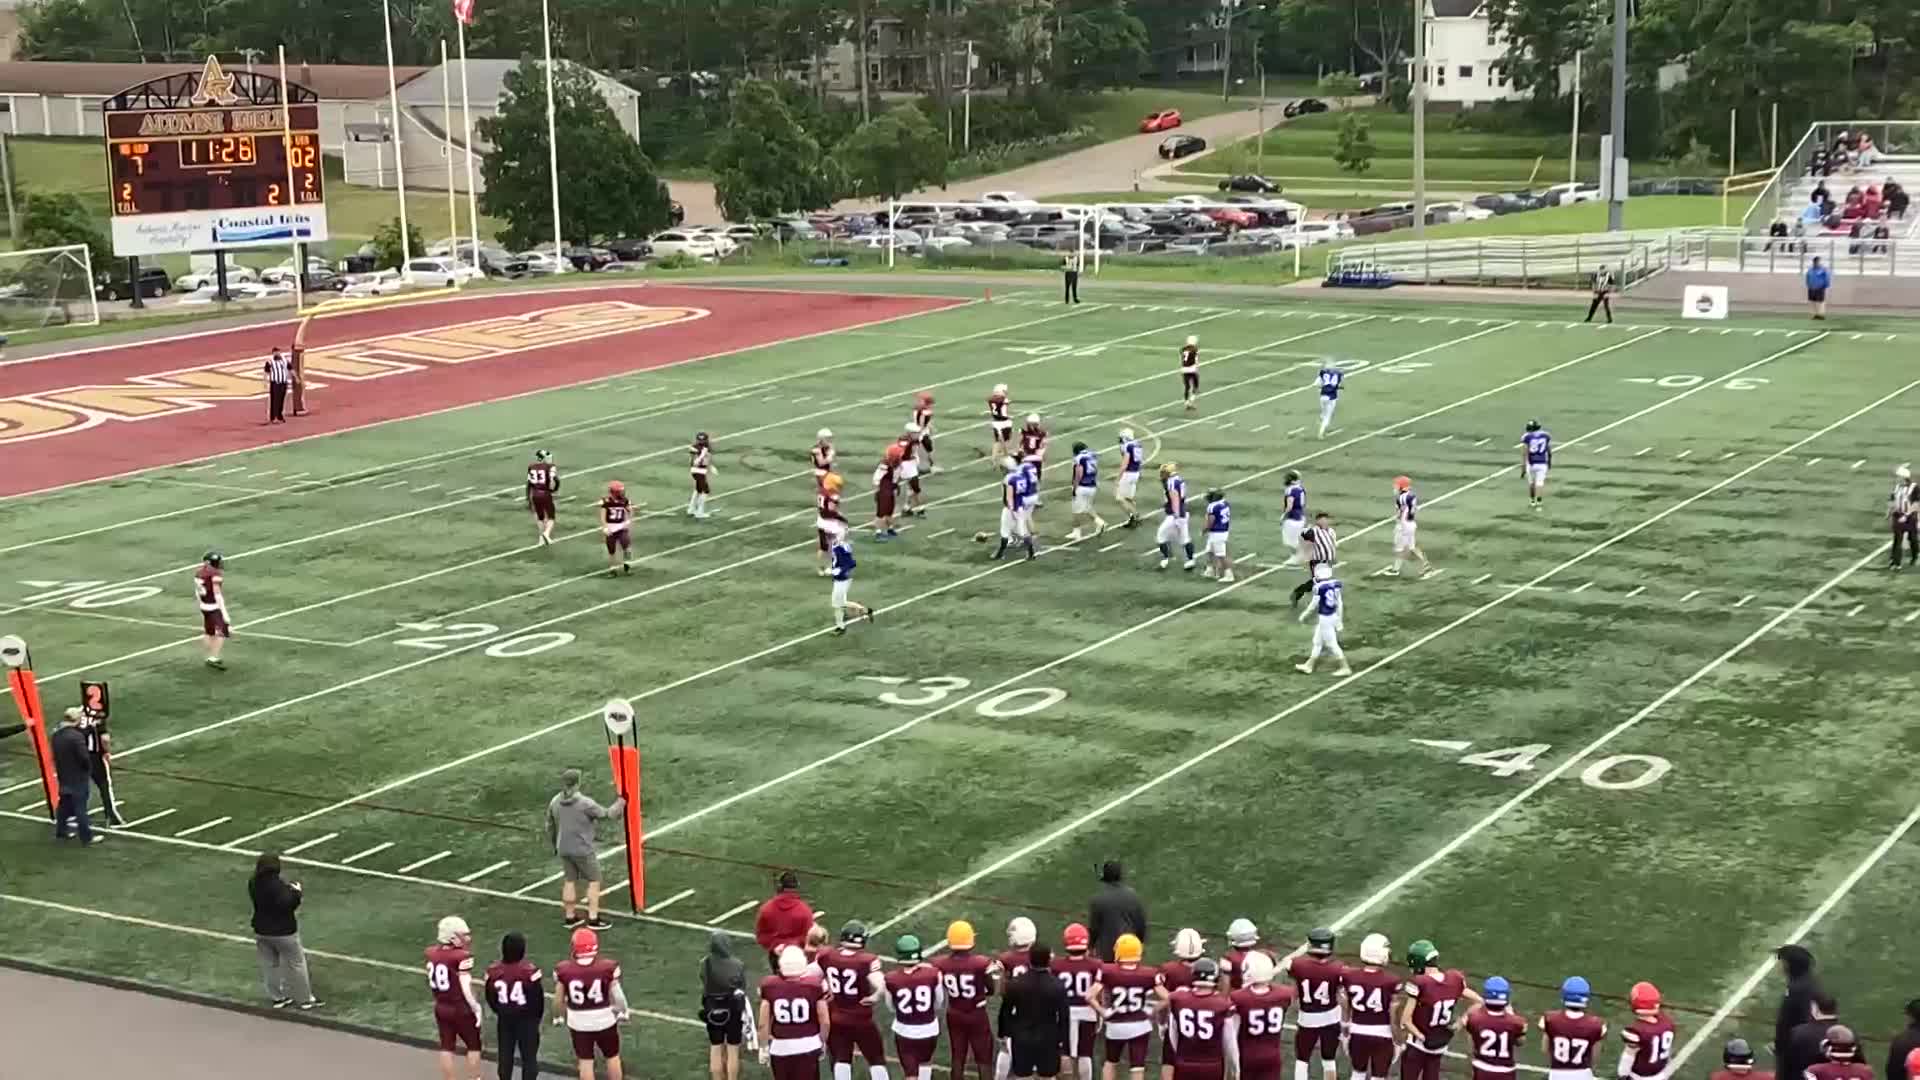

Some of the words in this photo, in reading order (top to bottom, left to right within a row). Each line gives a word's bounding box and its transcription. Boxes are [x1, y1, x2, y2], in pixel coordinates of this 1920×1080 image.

[138, 111, 224, 136] ALUMNI
[267, 184, 280, 205] 2
[218, 215, 274, 229] Coastal
[528, 469, 546, 484] 33
[392, 623, 576, 657] 20
[86, 685, 103, 711] 2
[878, 676, 1067, 717] 30
[1457, 743, 1673, 789] 40
[568, 979, 603, 1005] 64
[826, 966, 859, 995] 62
[944, 974, 977, 999] 95
[1301, 978, 1331, 1006] 14
[773, 998, 810, 1024] 60
[896, 985, 932, 1014] 29
[1111, 986, 1144, 1012] 25
[1349, 984, 1384, 1012] 24
[1179, 1007, 1215, 1040] 65
[1248, 1006, 1284, 1035] 59
[1429, 999, 1455, 1027] 15
[1479, 1029, 1510, 1058] 21
[1553, 1036, 1590, 1065] 87
[1649, 1031, 1675, 1063] 19
